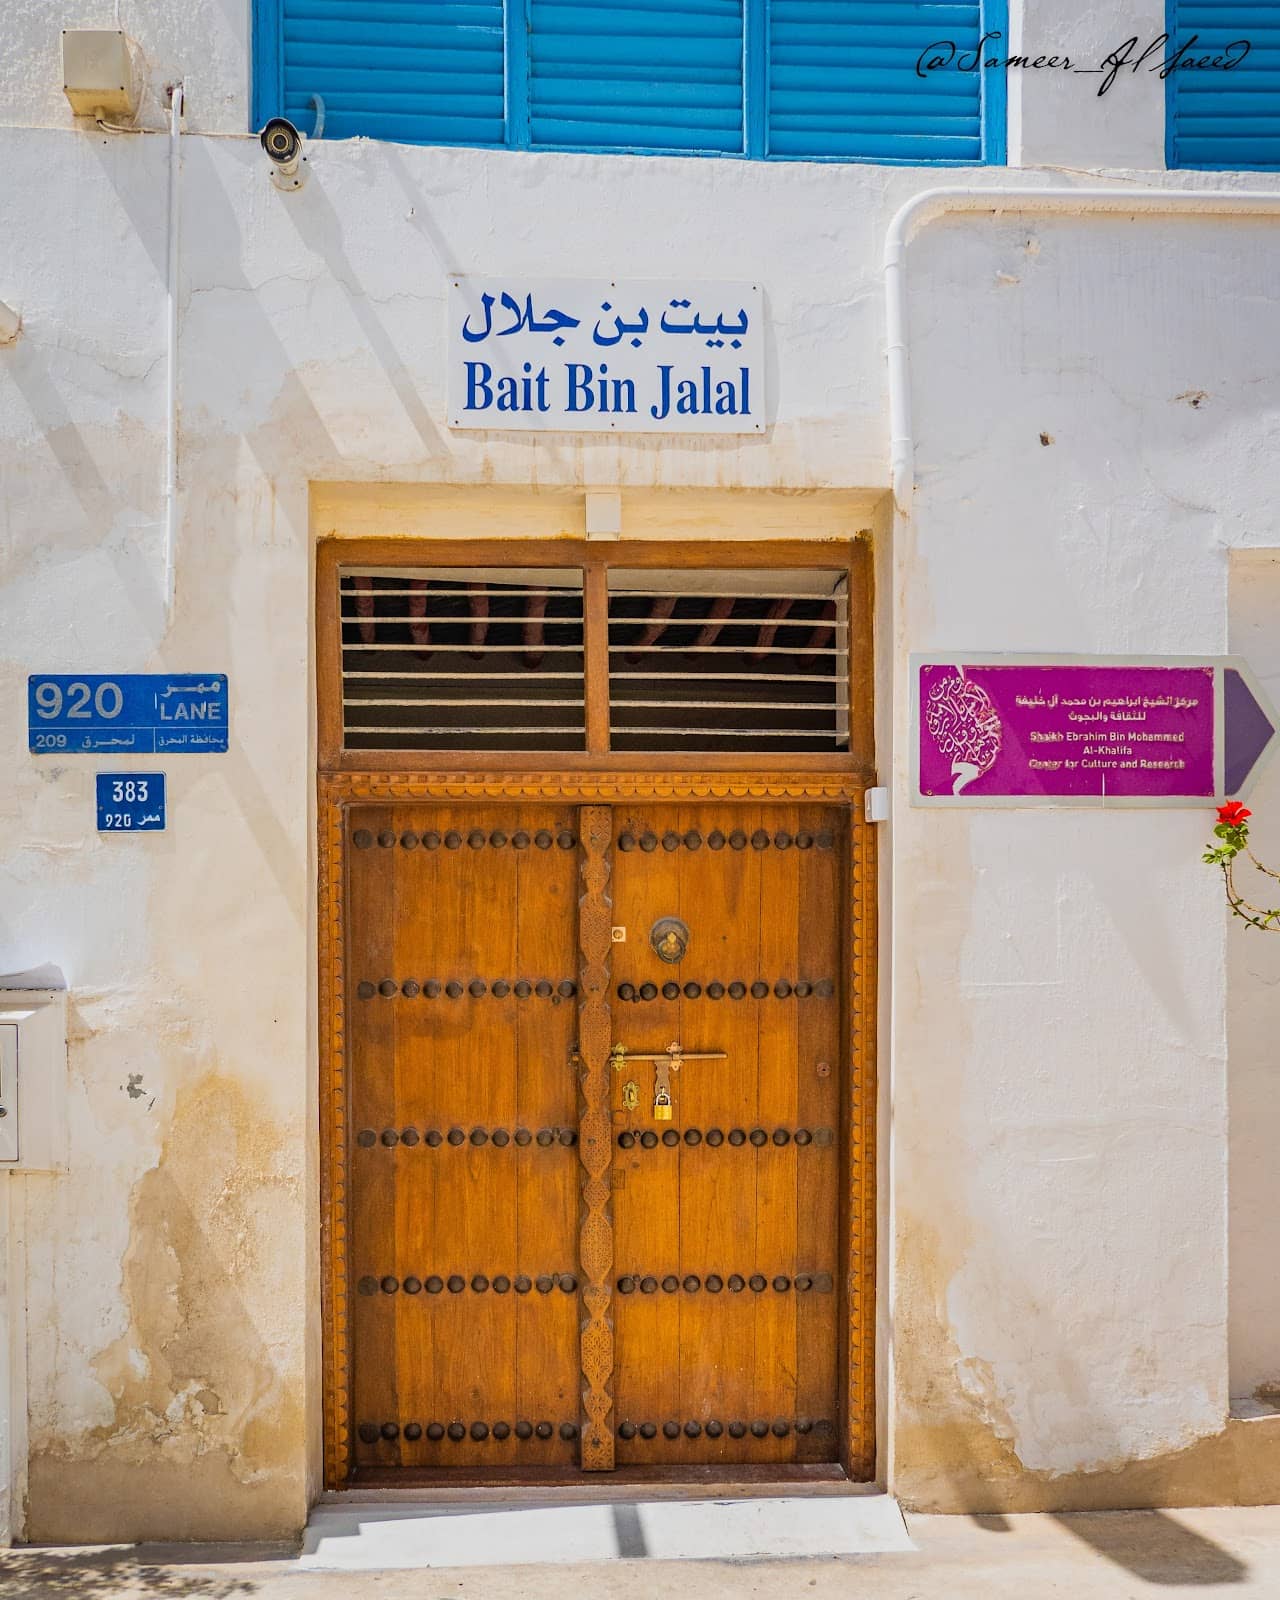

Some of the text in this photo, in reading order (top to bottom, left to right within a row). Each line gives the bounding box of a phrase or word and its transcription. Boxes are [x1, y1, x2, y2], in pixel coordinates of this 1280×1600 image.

[462, 291, 749, 350] بيت بن جلال
[463, 361, 751, 420] Bait Bin Jalal
[160, 681, 221, 698] ممر
[35, 681, 124, 720] 920
[1015, 695, 1046, 709] خليفة
[1060, 697, 1087, 706] محمد
[1088, 696, 1101, 708] بن
[1175, 696, 1199, 709] مركز
[160, 702, 222, 721] LANE
[1110, 710, 1146, 721] للثقافة
[35, 734, 67, 748] 209
[1030, 731, 1185, 743] Shaikh Ebrahim Bin Mohammed
[1082, 744, 1133, 755] Al-Khalifa
[1028, 758, 1185, 770] Center for Culture and Research
[112, 780, 149, 803] 383
[105, 813, 161, 828] ممر 920
